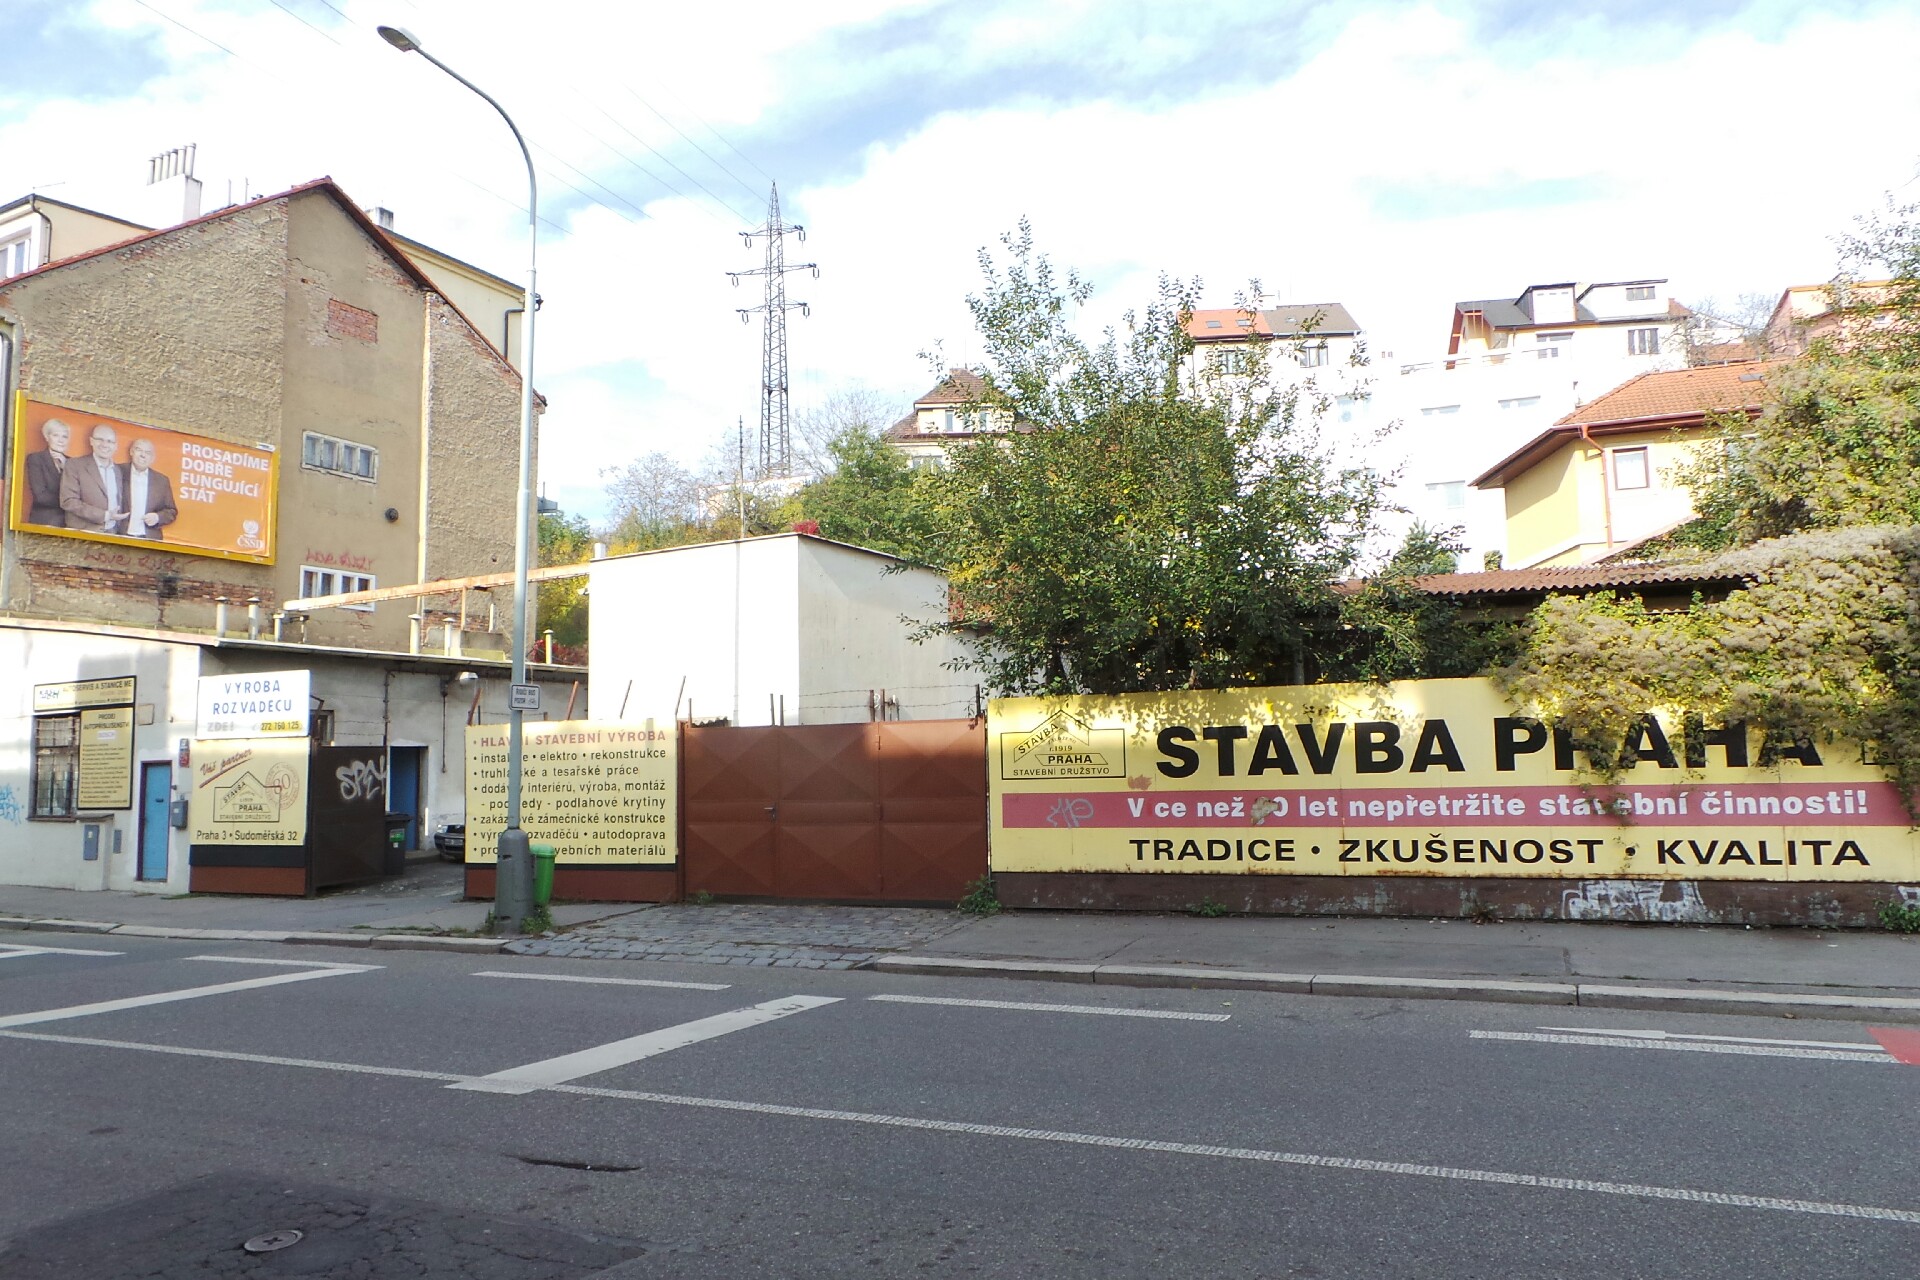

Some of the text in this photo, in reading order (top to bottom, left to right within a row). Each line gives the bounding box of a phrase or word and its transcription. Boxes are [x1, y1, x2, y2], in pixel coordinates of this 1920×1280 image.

[182, 442, 269, 471] PROSADÍME
[181, 457, 233, 478] DOBŘE
[180, 472, 259, 497] FUNGUJÍCÍ
[179, 486, 216, 503] STÁT
[481, 729, 666, 747] HLAÍ STAVEBNÍ VÝROBA
[1018, 723, 1058, 754] STAVBA
[481, 748, 666, 763] instale elektro rekonstrukce
[1156, 719, 1466, 778] STAVBA
[1048, 755, 1092, 764] PRAHA
[481, 764, 639, 778] truhlké a tesařské práce
[1013, 767, 1110, 776] STAVEBNÍ DRUŽSTVO
[625, 780, 666, 791] montáž
[238, 804, 263, 812] PRAHA
[556, 797, 618, 810] podlahové
[623, 796, 666, 809] krytiny
[1197, 797, 1245, 818] než
[1299, 796, 1338, 817] let
[1701, 789, 1868, 816] činnosti!
[480, 812, 666, 824] zakázvé zámečnické konstrukce
[197, 830, 219, 840] Praha
[222, 830, 227, 840] 3
[288, 830, 298, 840] 32
[527, 828, 579, 840] ozvaděčů
[592, 829, 666, 842] autodoprava
[554, 844, 601, 856] vebních
[608, 844, 666, 855] materiálů
[1129, 833, 1871, 866] TRADICE ZKUŠENOST KVALITA
